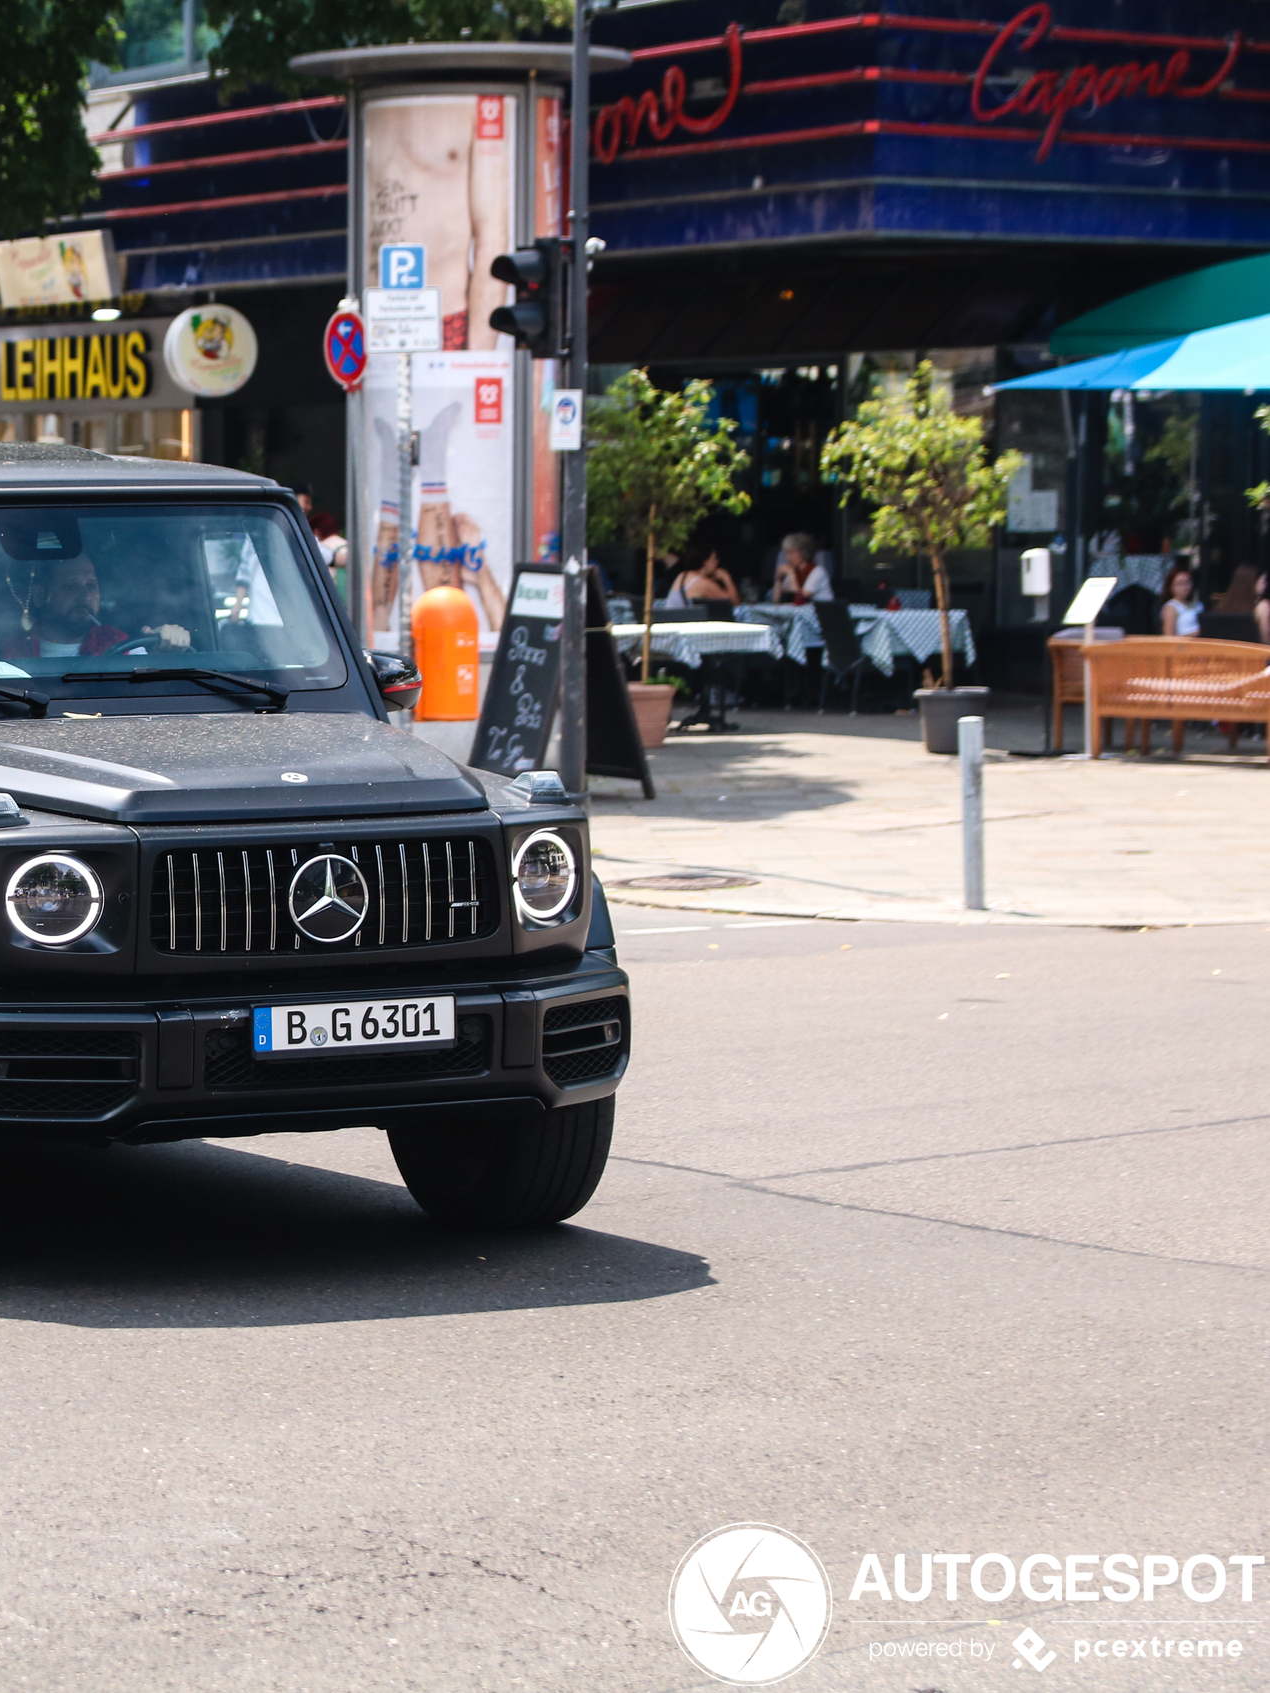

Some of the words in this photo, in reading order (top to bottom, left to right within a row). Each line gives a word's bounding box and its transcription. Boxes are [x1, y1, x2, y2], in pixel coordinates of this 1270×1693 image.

[593, 20, 742, 165] one
[970, 2, 1242, 164] Capone
[390, 249, 416, 287] P
[0, 330, 146, 401] LEIHHAUS
[258, 1034, 267, 1045] D
[287, 1010, 308, 1045] B
[331, 1007, 352, 1042] G
[360, 1002, 441, 1040] 6301
